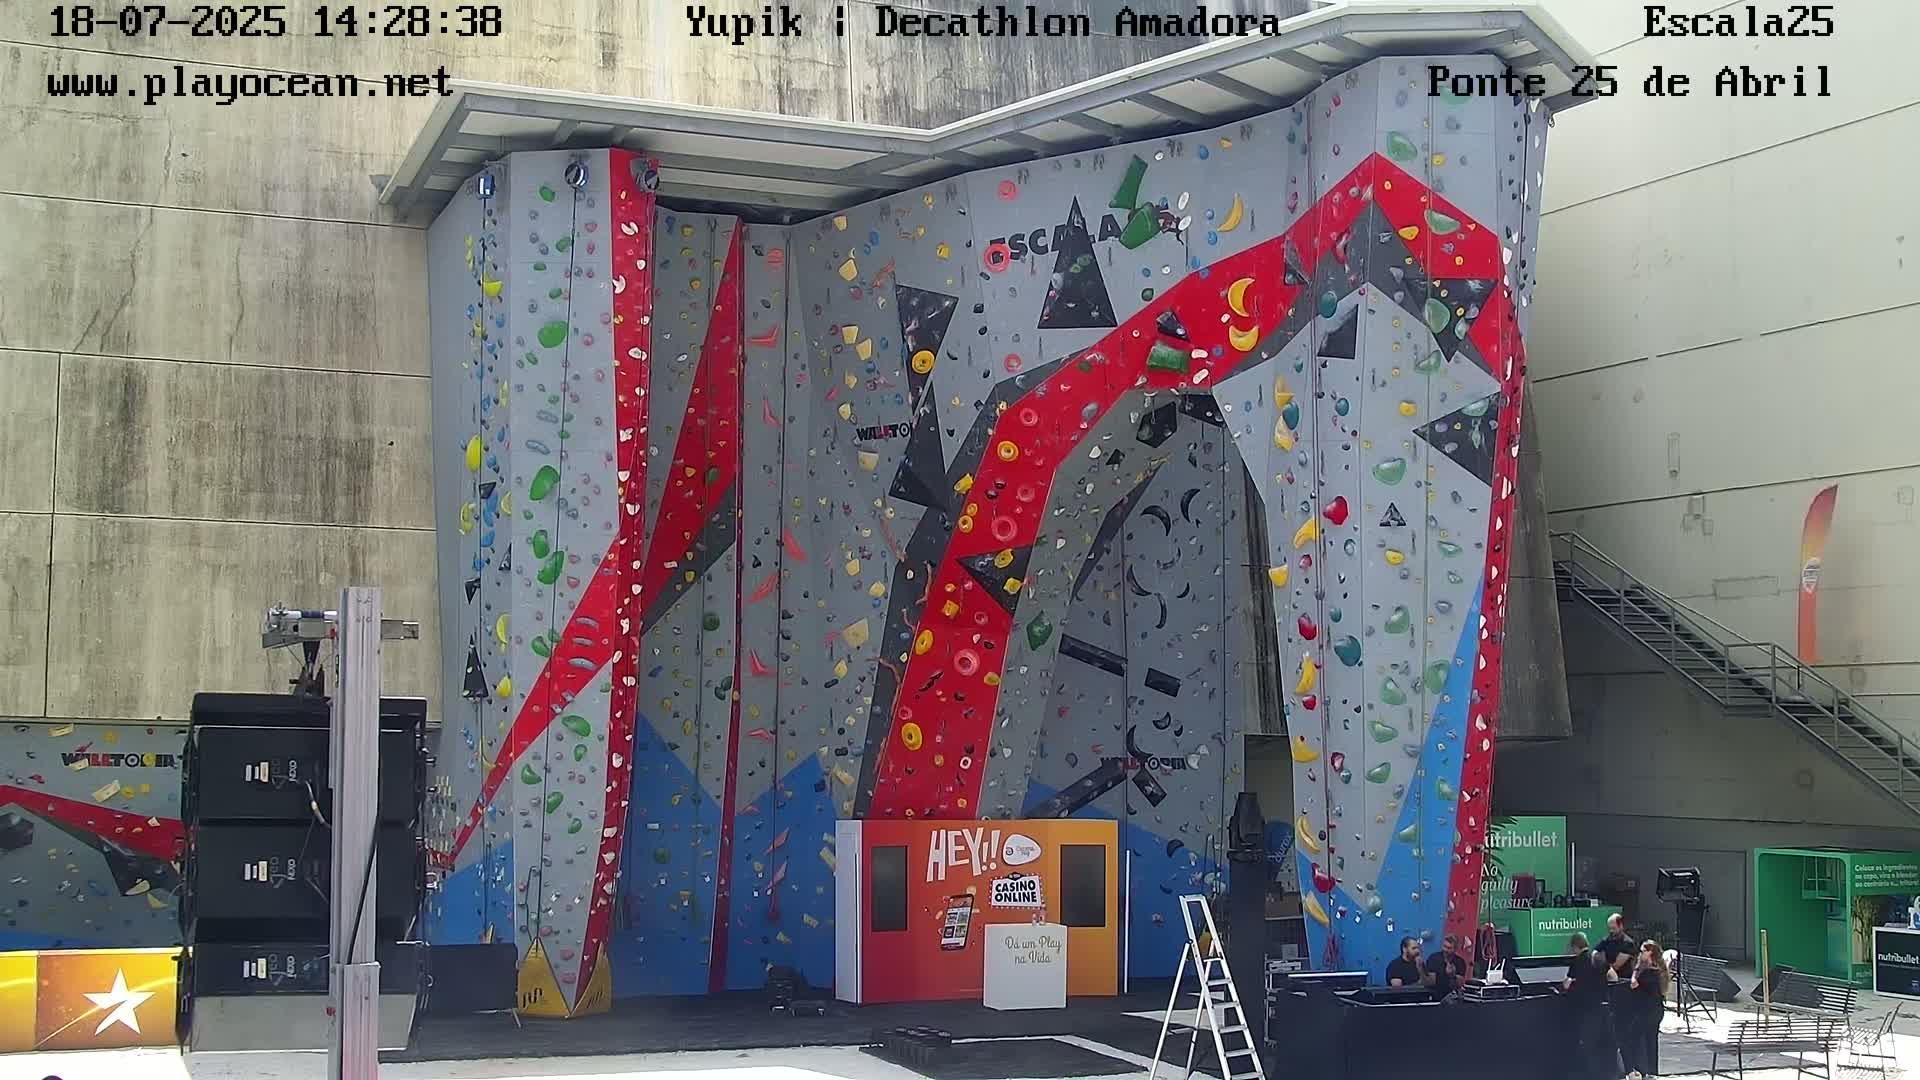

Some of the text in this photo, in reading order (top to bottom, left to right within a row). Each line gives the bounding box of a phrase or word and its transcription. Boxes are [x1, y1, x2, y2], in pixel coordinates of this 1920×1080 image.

[1484, 830, 1558, 848] utribullet
[926, 826, 1001, 883] HEY!!
[995, 879, 1036, 893] CASINO
[994, 891, 1038, 903] ONLINE
[1538, 917, 1593, 931] nutribullet
